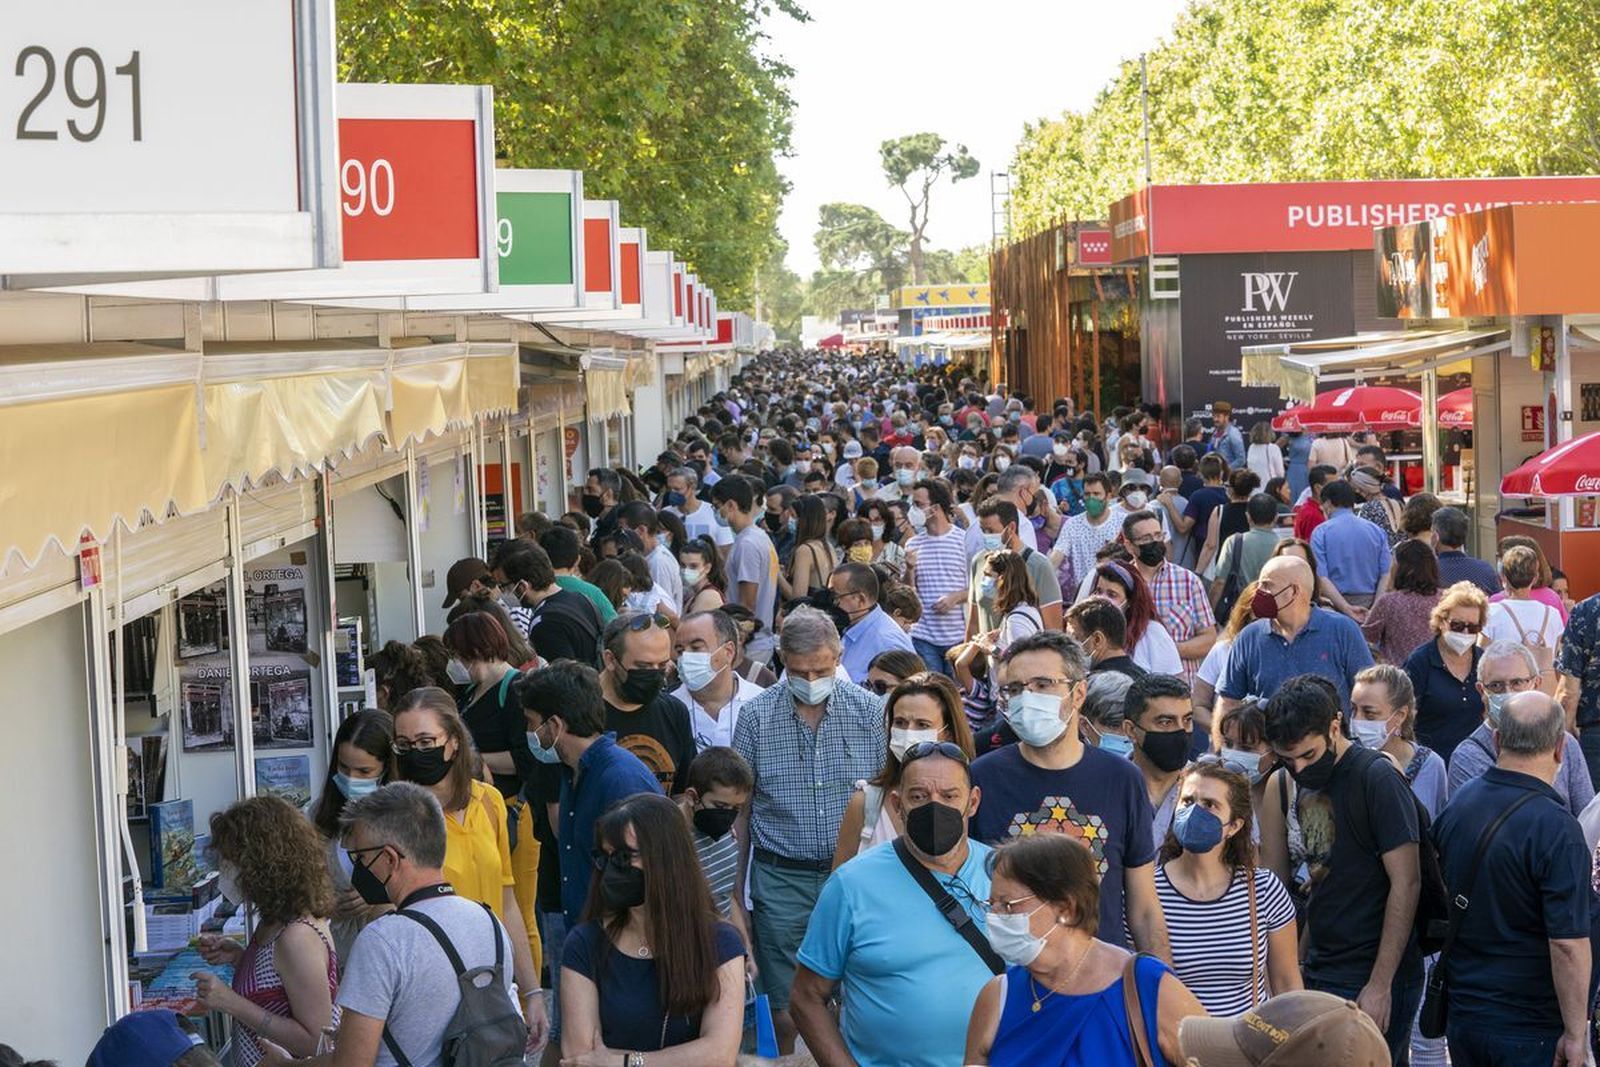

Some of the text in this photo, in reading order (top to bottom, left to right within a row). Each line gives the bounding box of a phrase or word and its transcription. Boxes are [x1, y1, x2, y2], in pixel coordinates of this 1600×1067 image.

[15, 45, 142, 142] 291
[341, 158, 395, 216] 90
[1288, 202, 1456, 228] PUBLISHERS
[1241, 272, 1299, 311] PW
[1243, 320, 1296, 329] EN ESPAÑOL
[1278, 331, 1311, 339] SEVILLA
[254, 568, 304, 581] ORTEGA
[198, 667, 232, 679] DANIE
